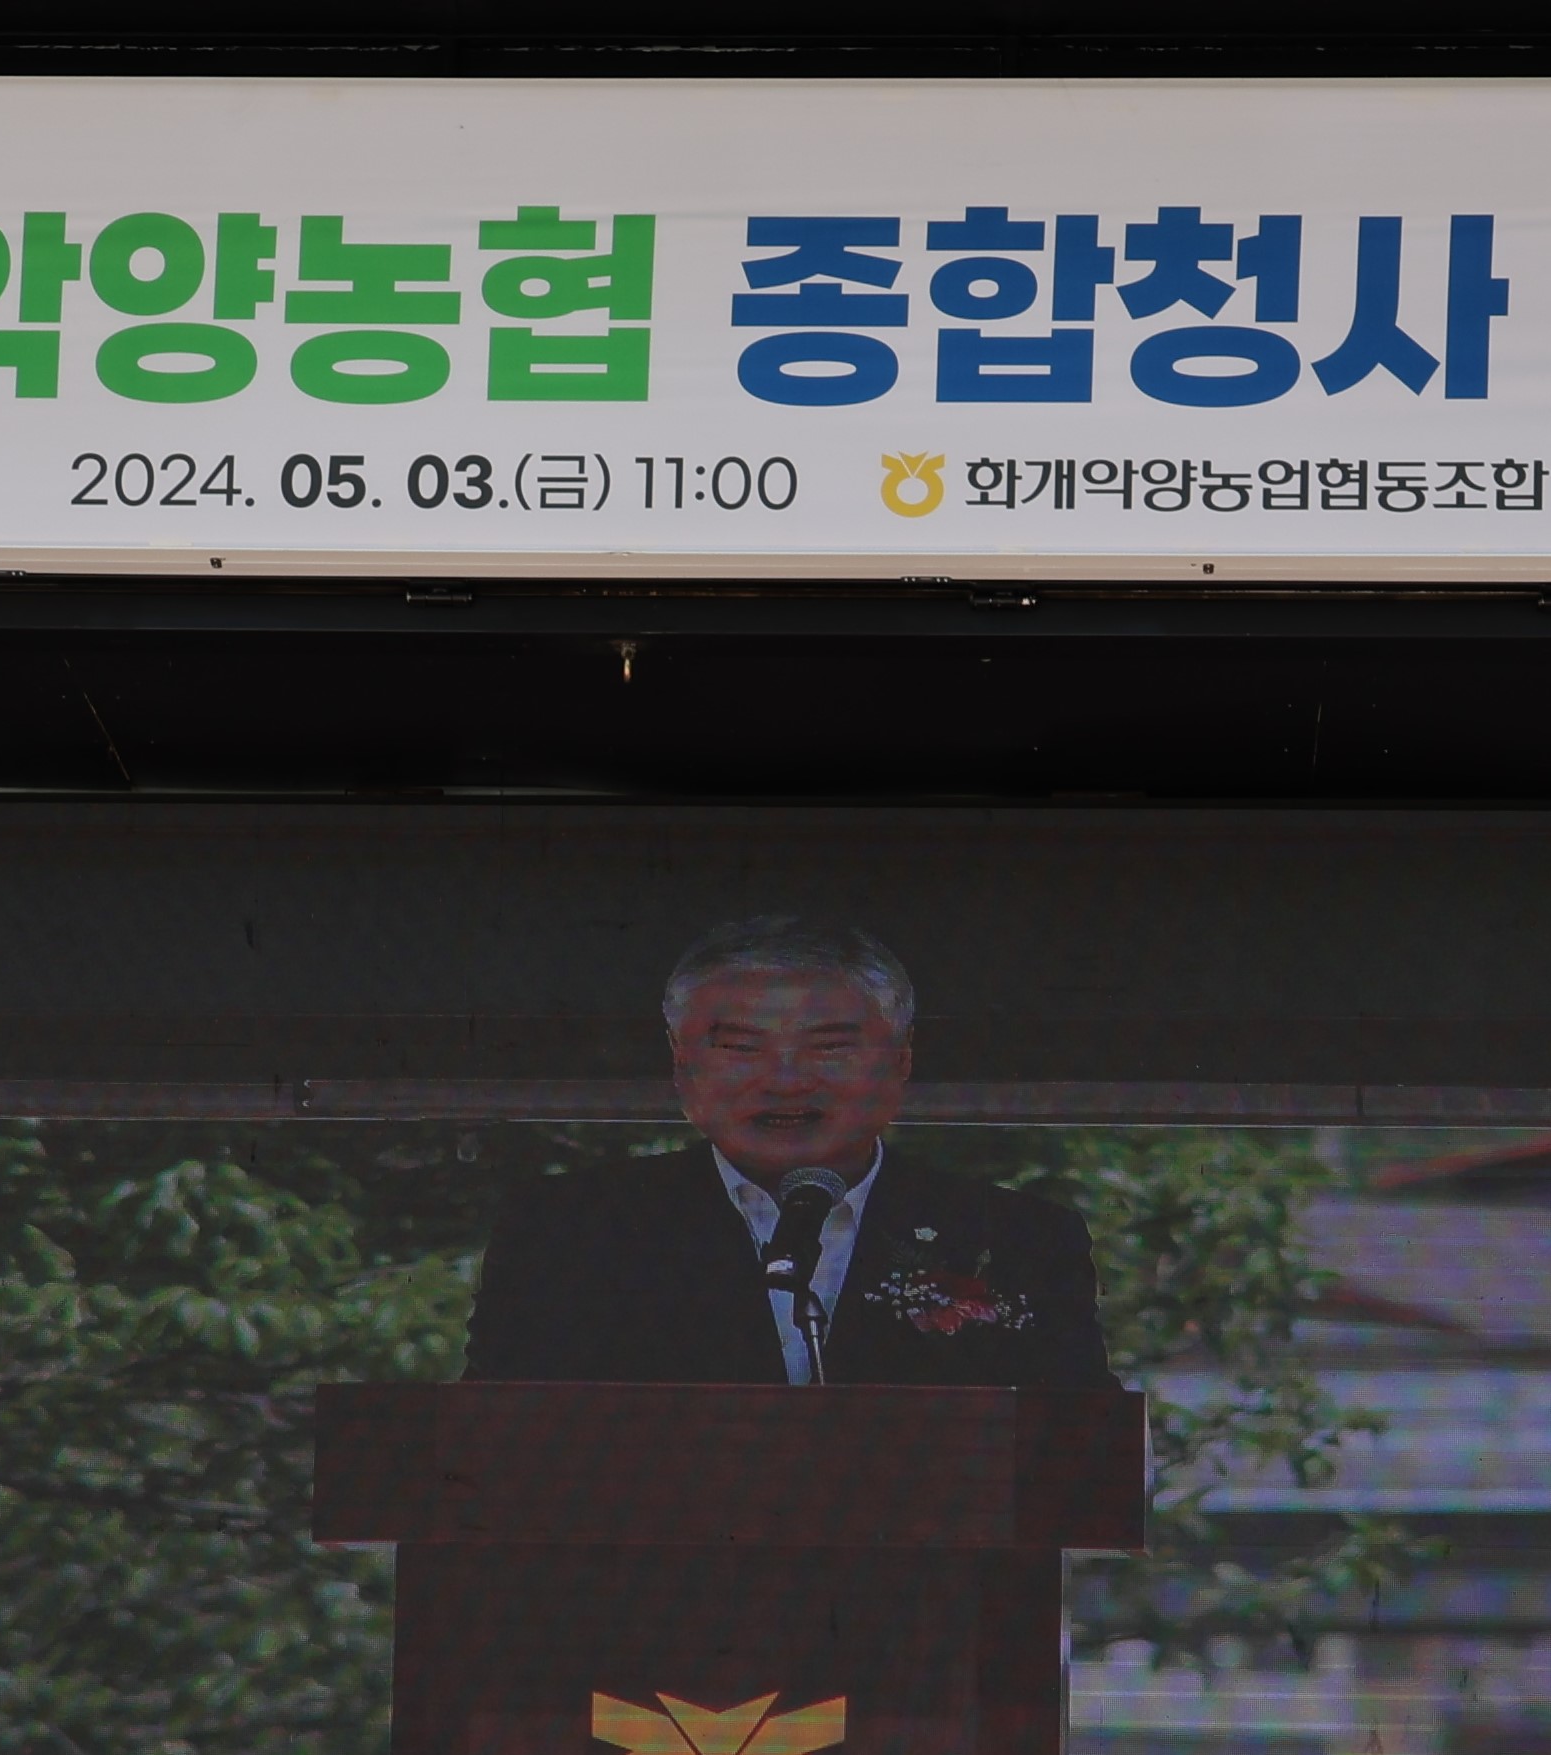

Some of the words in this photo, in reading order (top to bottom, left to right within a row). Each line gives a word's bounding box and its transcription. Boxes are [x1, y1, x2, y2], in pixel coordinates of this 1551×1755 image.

[731, 207, 1510, 408] 종합청사
[70, 452, 255, 508] 2024.
[280, 452, 382, 510] 05.
[407, 452, 612, 512] 03.(금)
[635, 456, 798, 511] 11:00
[965, 457, 1550, 513] 화개악양농업협동조합
